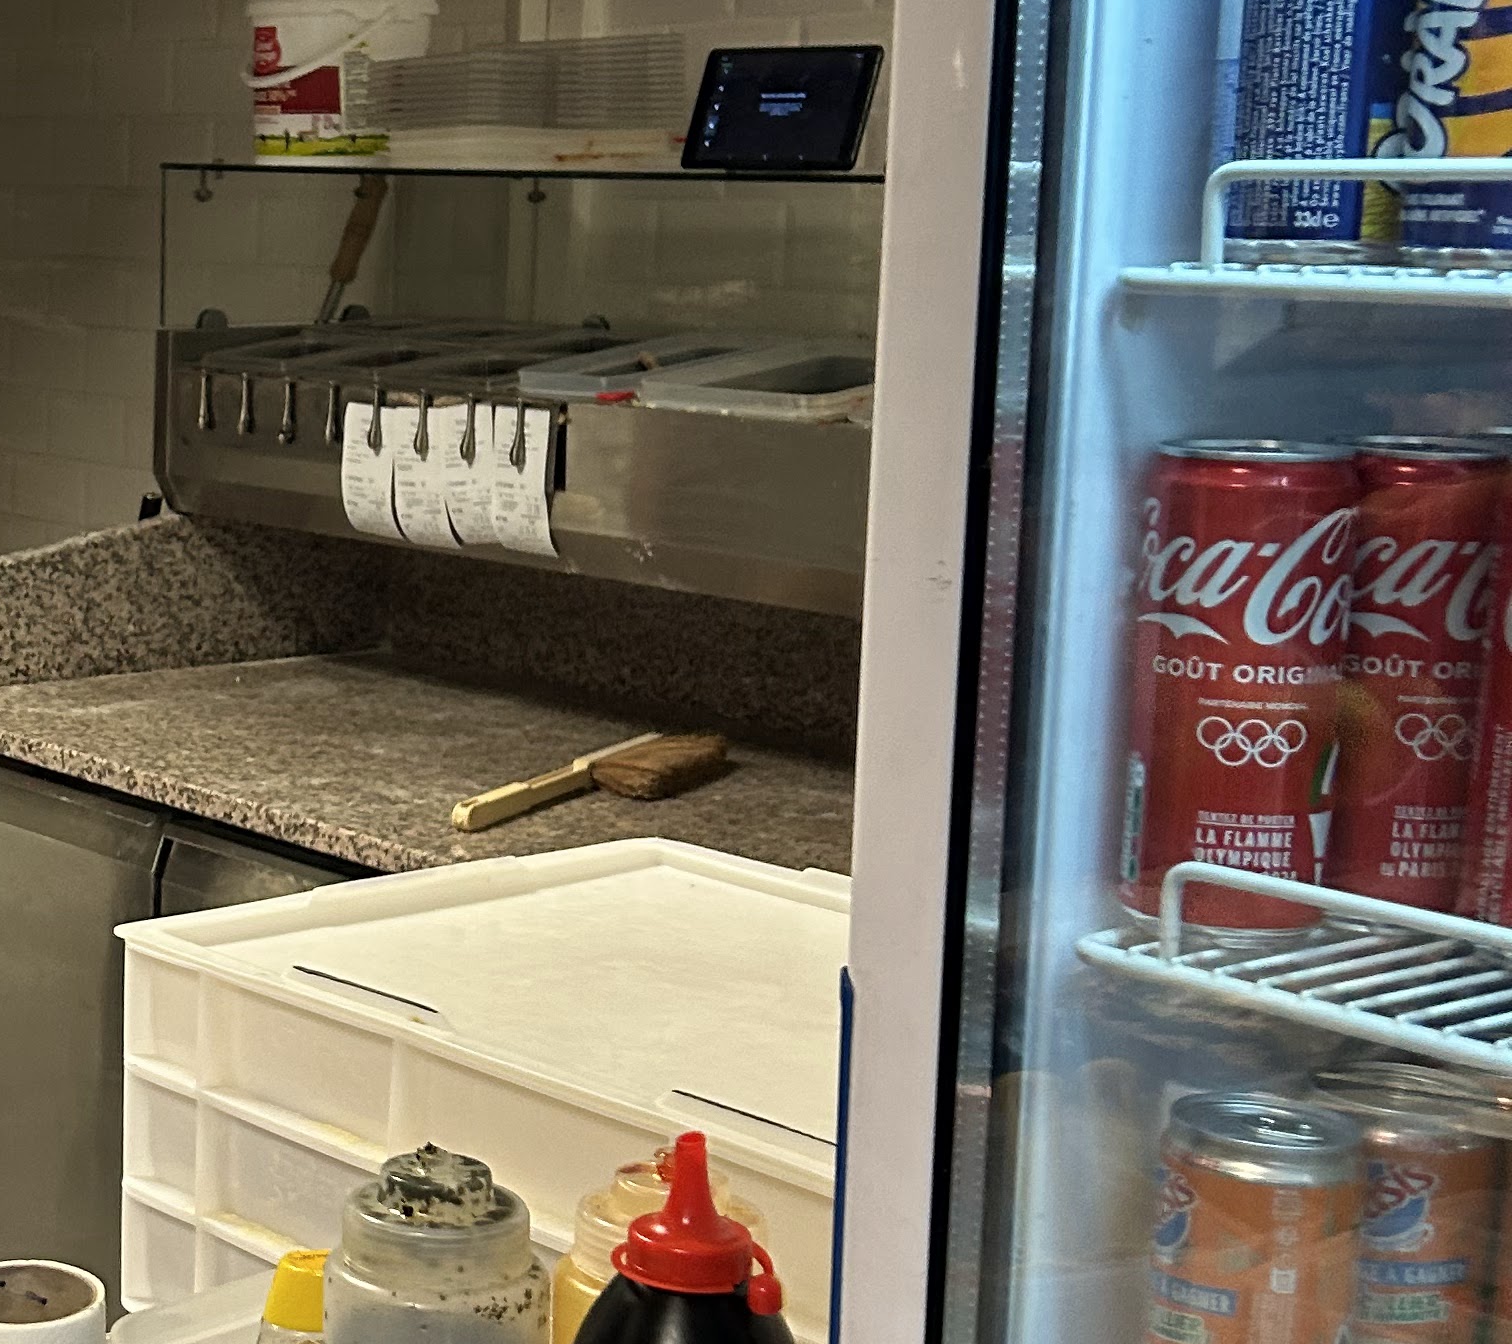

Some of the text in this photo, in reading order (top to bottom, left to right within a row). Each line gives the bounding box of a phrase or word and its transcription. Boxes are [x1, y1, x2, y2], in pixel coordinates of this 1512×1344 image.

[1151, 656, 1225, 683] GOÛT
[1195, 827, 1293, 849] LA FLAMME
[1193, 847, 1291, 869] OLYMPIQUE
